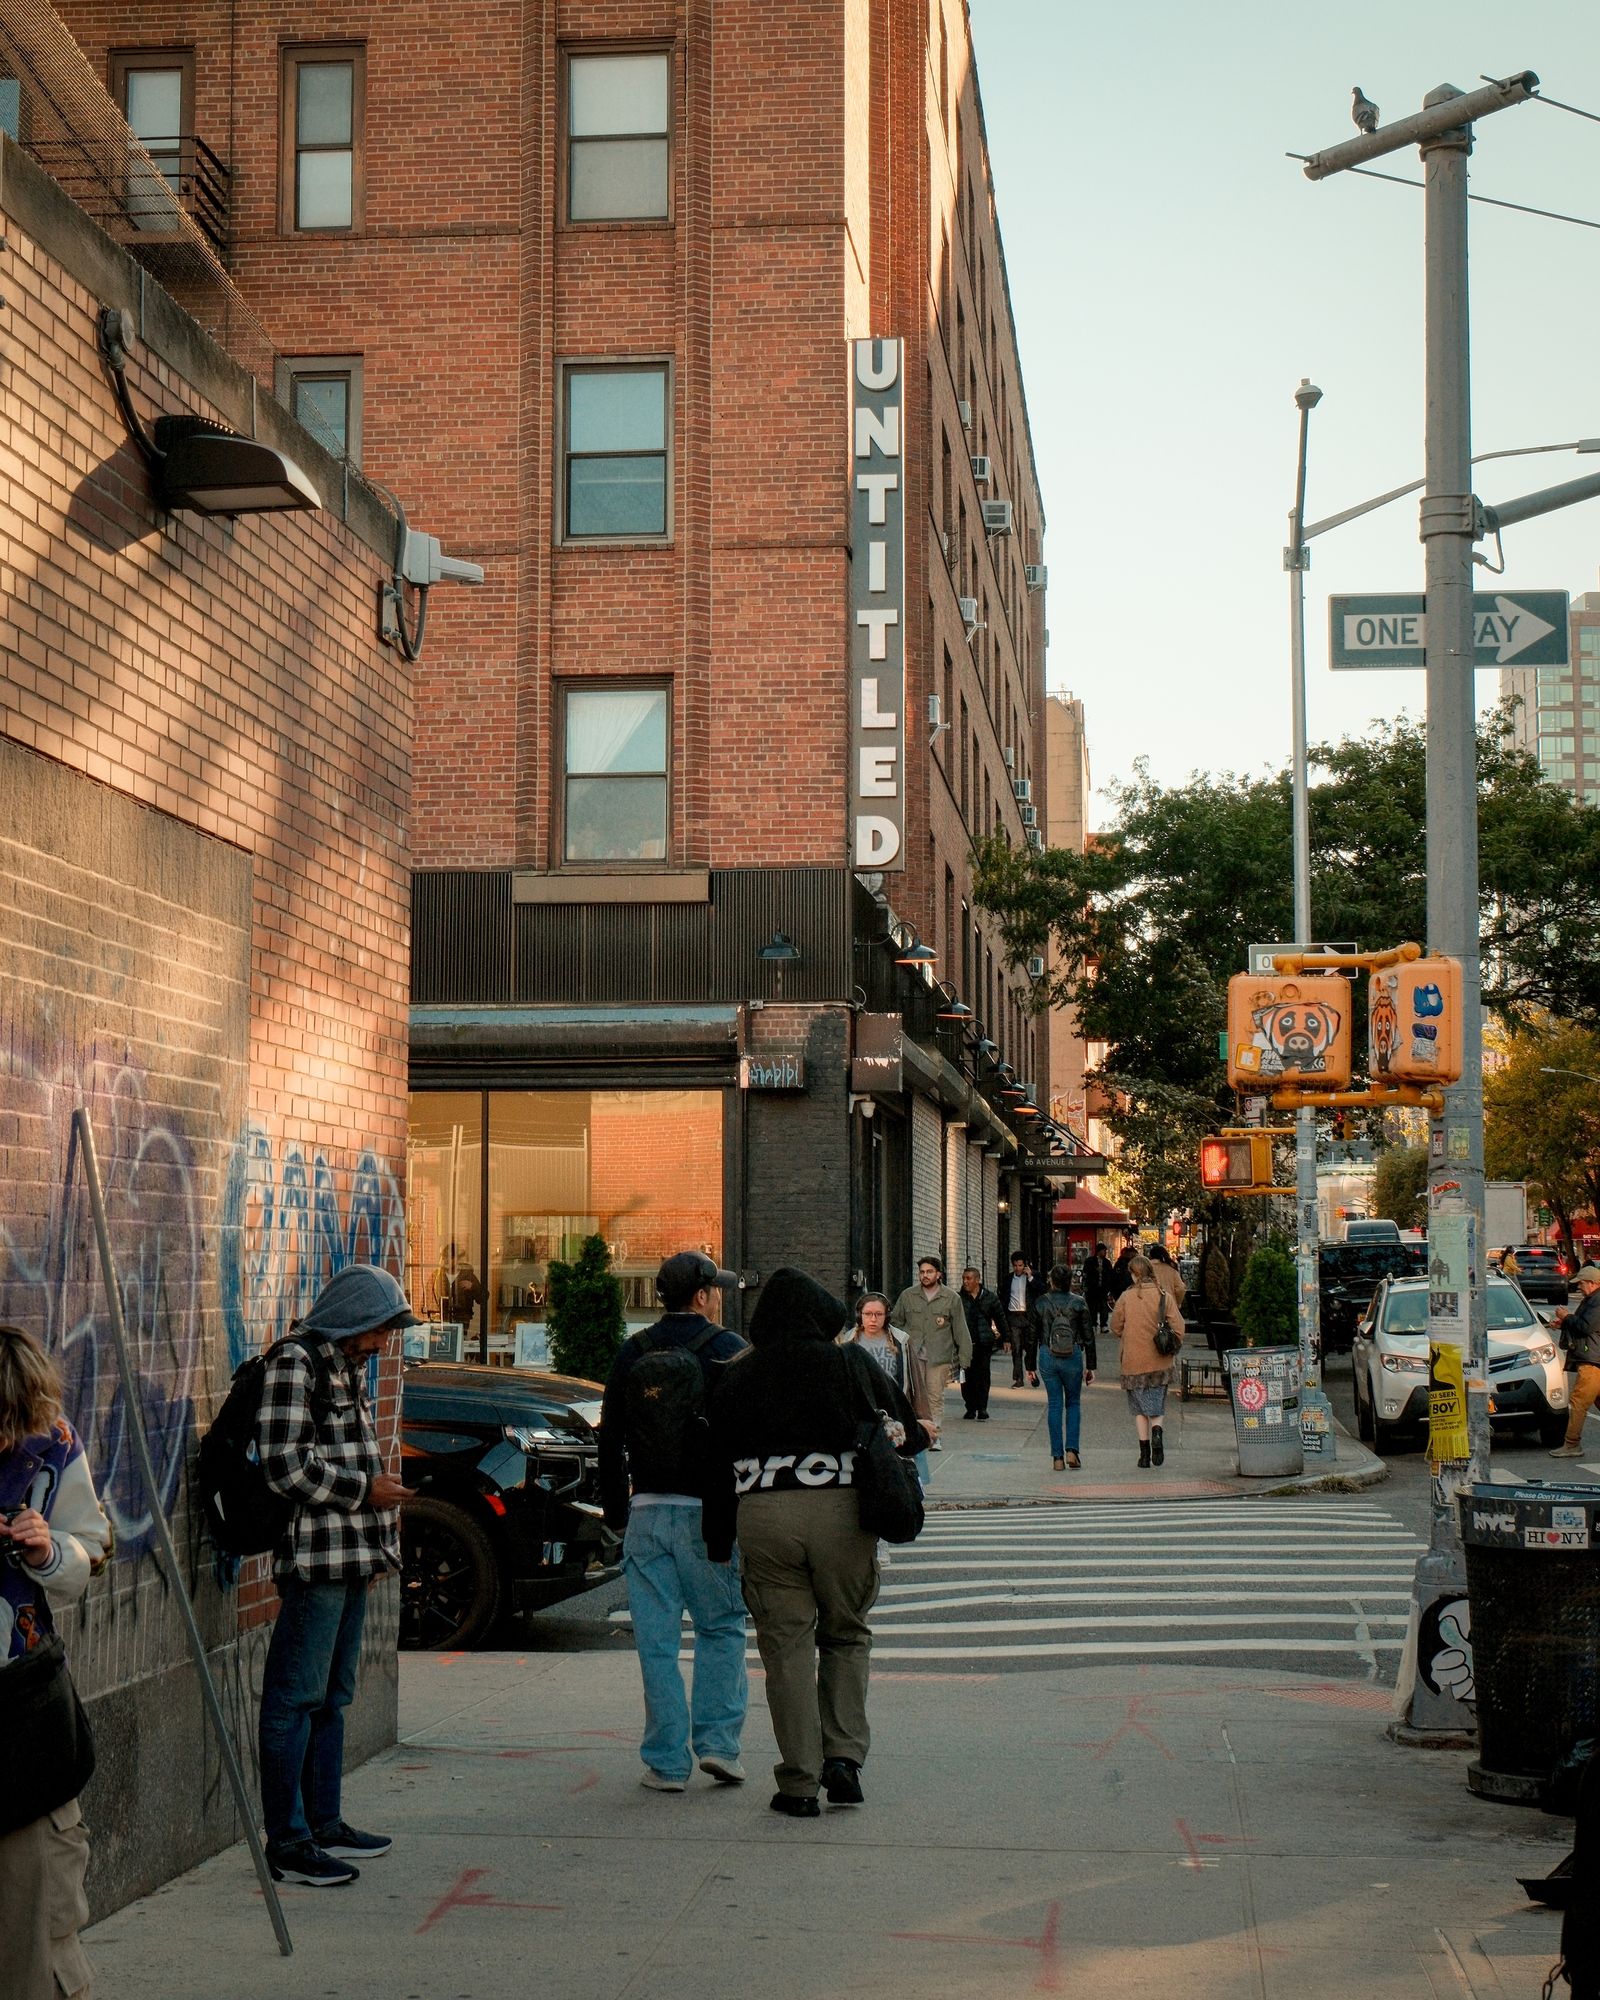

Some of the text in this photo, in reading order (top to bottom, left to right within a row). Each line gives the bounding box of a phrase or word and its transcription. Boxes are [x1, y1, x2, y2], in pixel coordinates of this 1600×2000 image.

[855, 339, 900, 867] UNTITLED
[1356, 615, 1520, 646] ONE AY
[1036, 1158, 1066, 1166] AVENUE
[1067, 1158, 1074, 1166] A
[1438, 1390, 1457, 1399] SEEN
[1432, 1401, 1456, 1415] BOY
[1514, 1490, 1536, 1500] Please
[1537, 1492, 1555, 1500] Don't
[1473, 1511, 1516, 1533] NYC
[1527, 1531, 1586, 1544] HI NY
